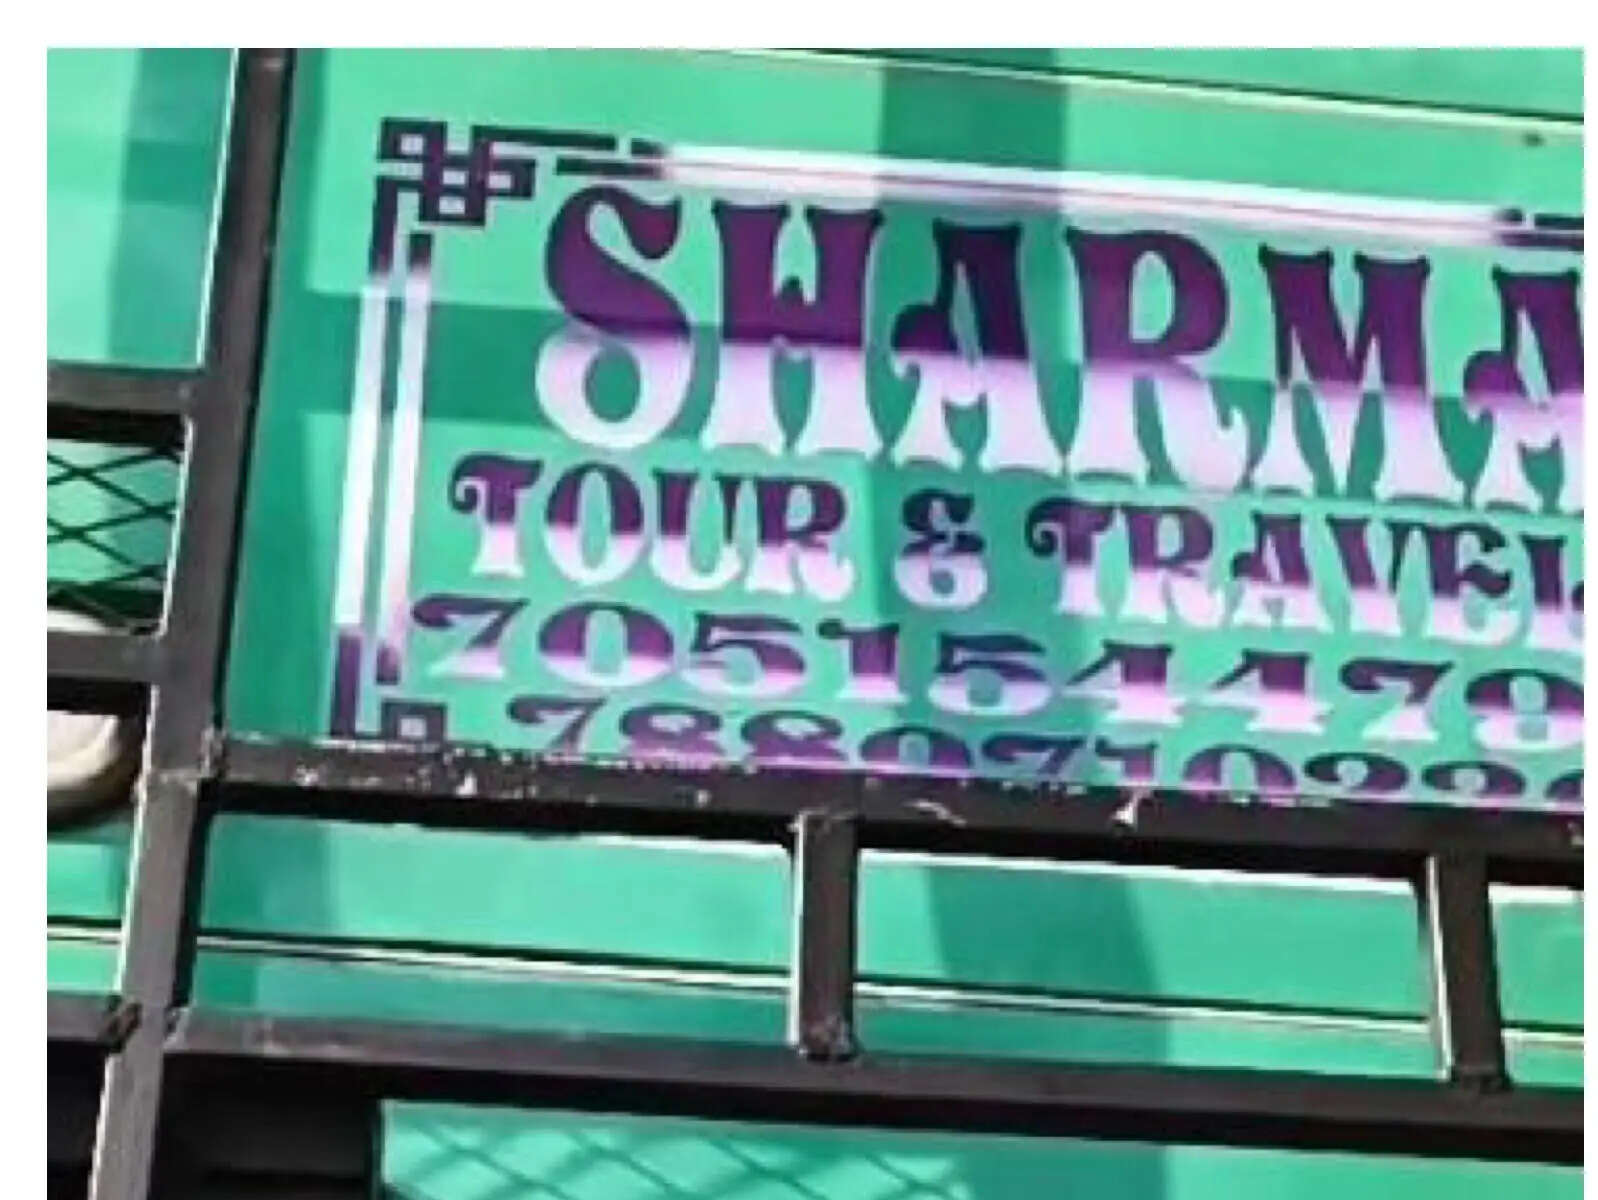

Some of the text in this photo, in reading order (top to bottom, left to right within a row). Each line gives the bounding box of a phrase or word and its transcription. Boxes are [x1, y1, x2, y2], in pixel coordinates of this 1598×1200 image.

[535, 183, 1584, 515] SHARMA
[448, 455, 854, 600] TOUR
[892, 487, 989, 612] &
